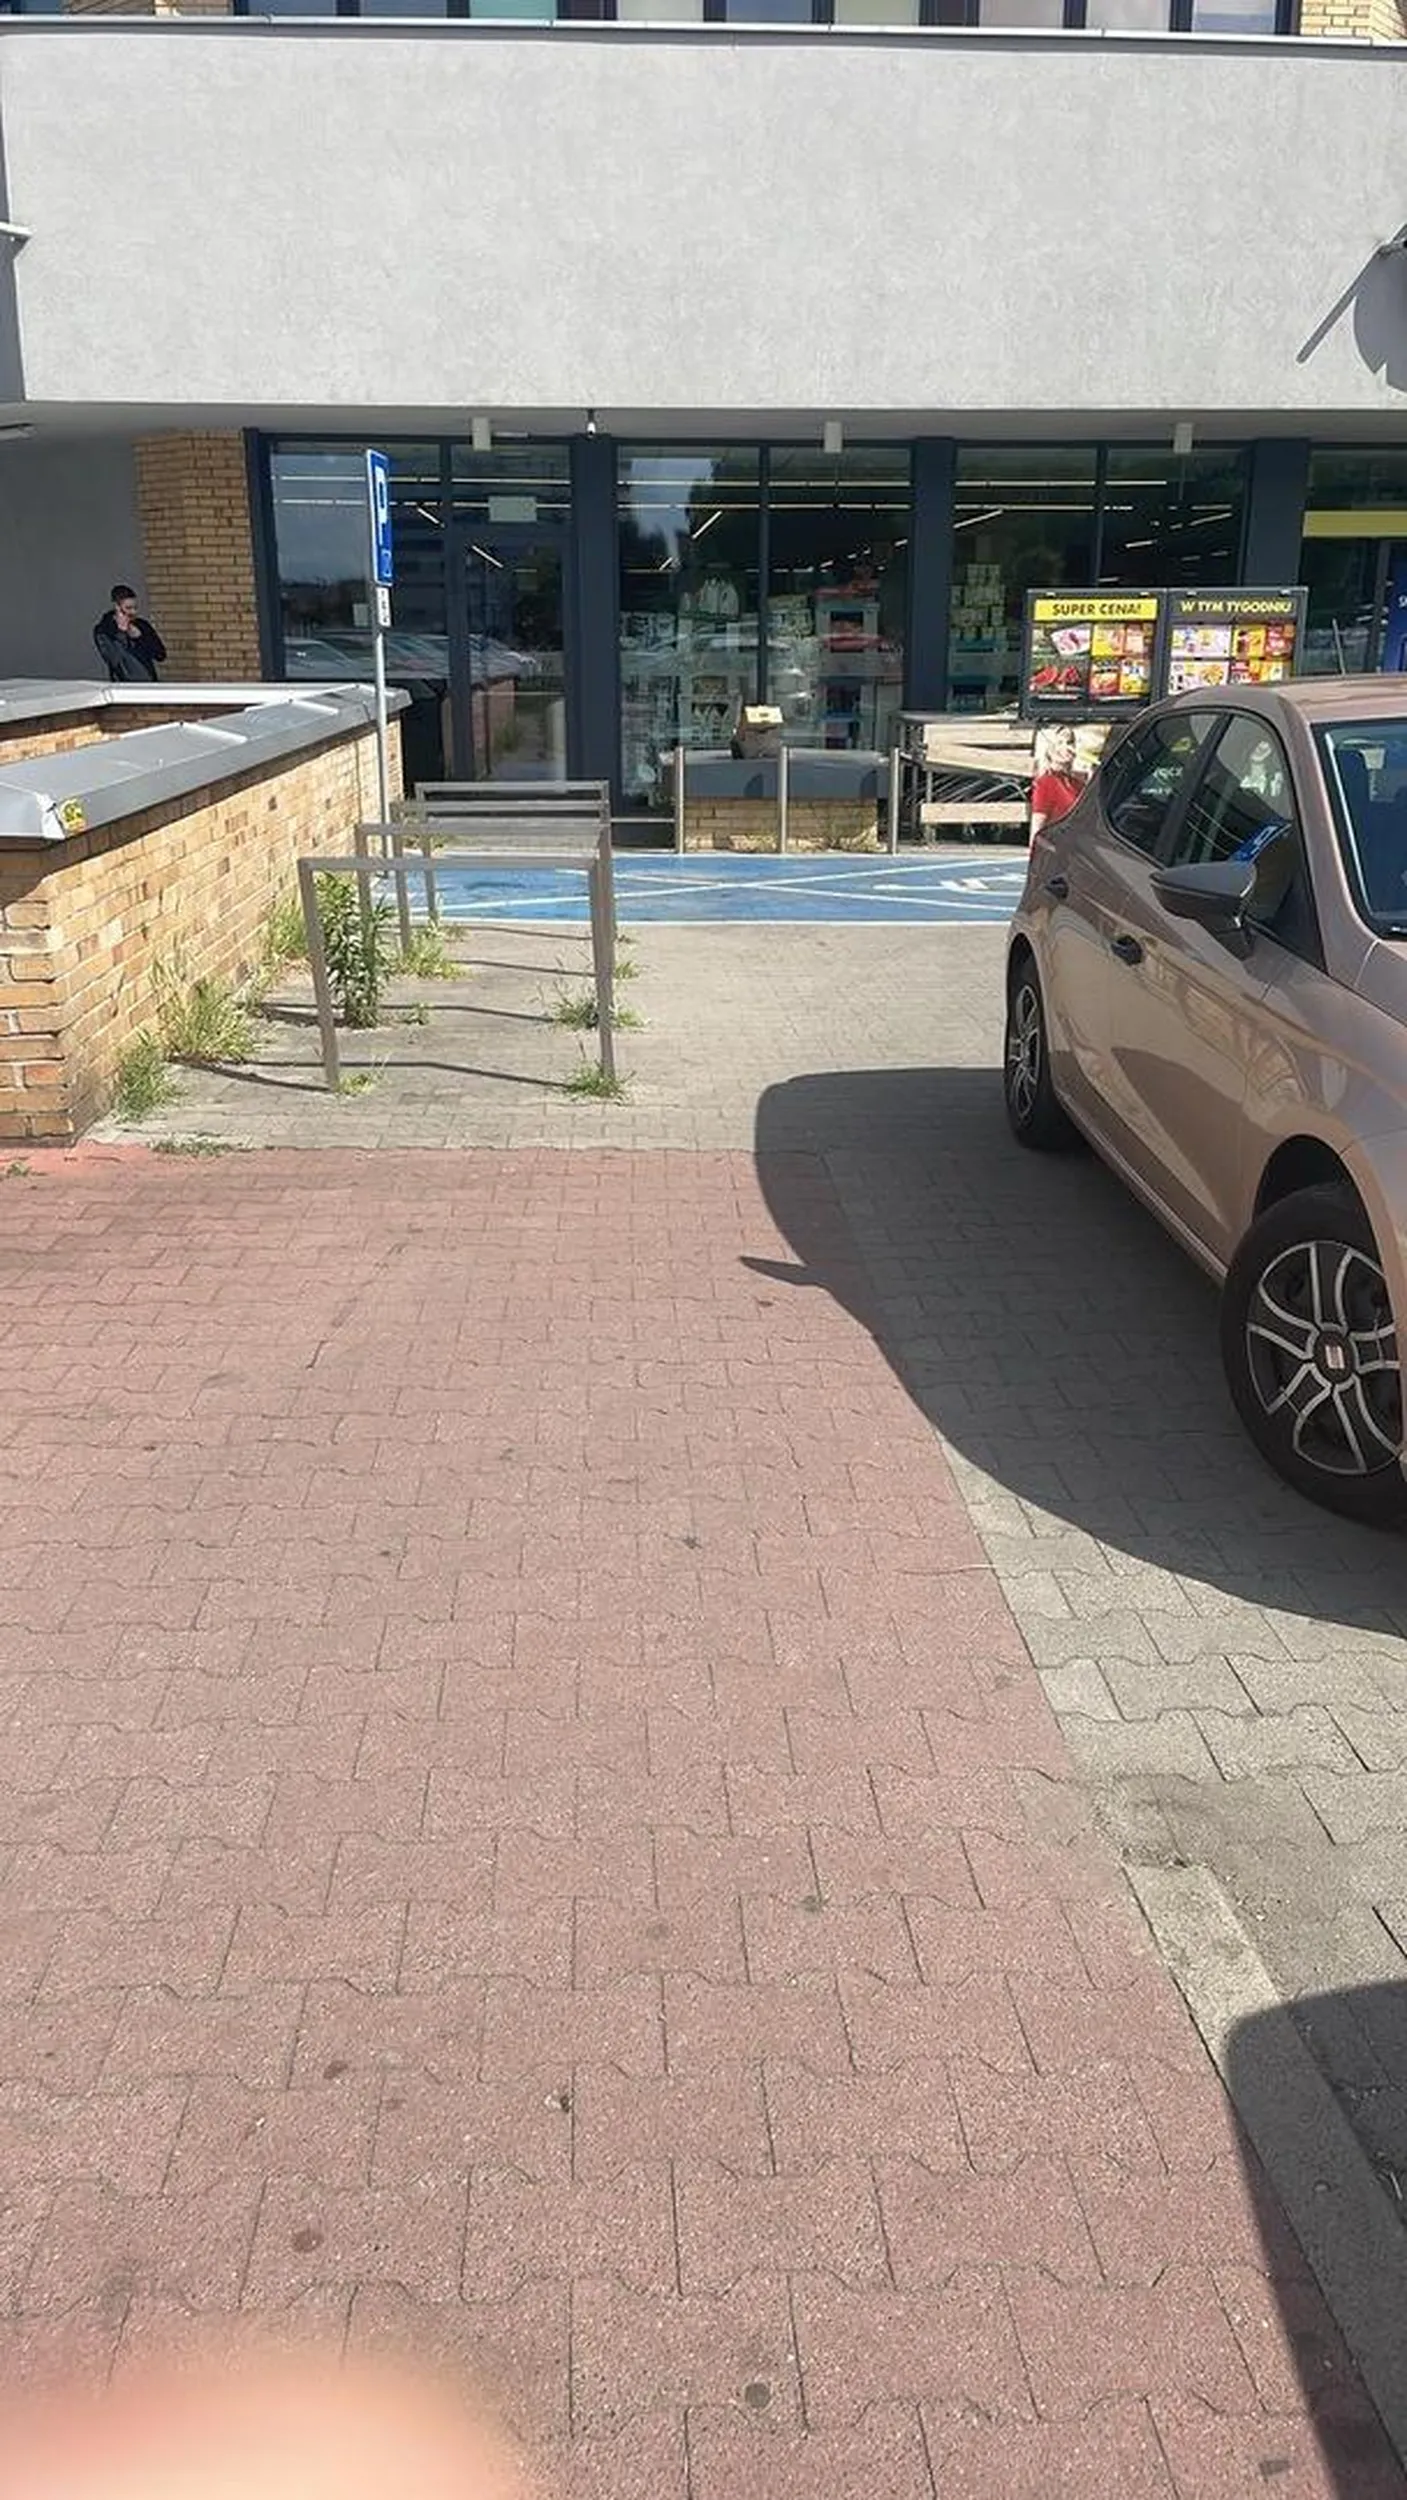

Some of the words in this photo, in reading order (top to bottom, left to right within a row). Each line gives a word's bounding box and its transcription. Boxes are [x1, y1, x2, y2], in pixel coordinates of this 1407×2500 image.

[375, 466, 387, 545] P
[1052, 603, 1095, 616] SUPER
[1099, 603, 1142, 615] CENA!
[1181, 600, 1196, 613] W
[1198, 600, 1223, 613] TYM
[1226, 600, 1292, 613] TYGODNIU
